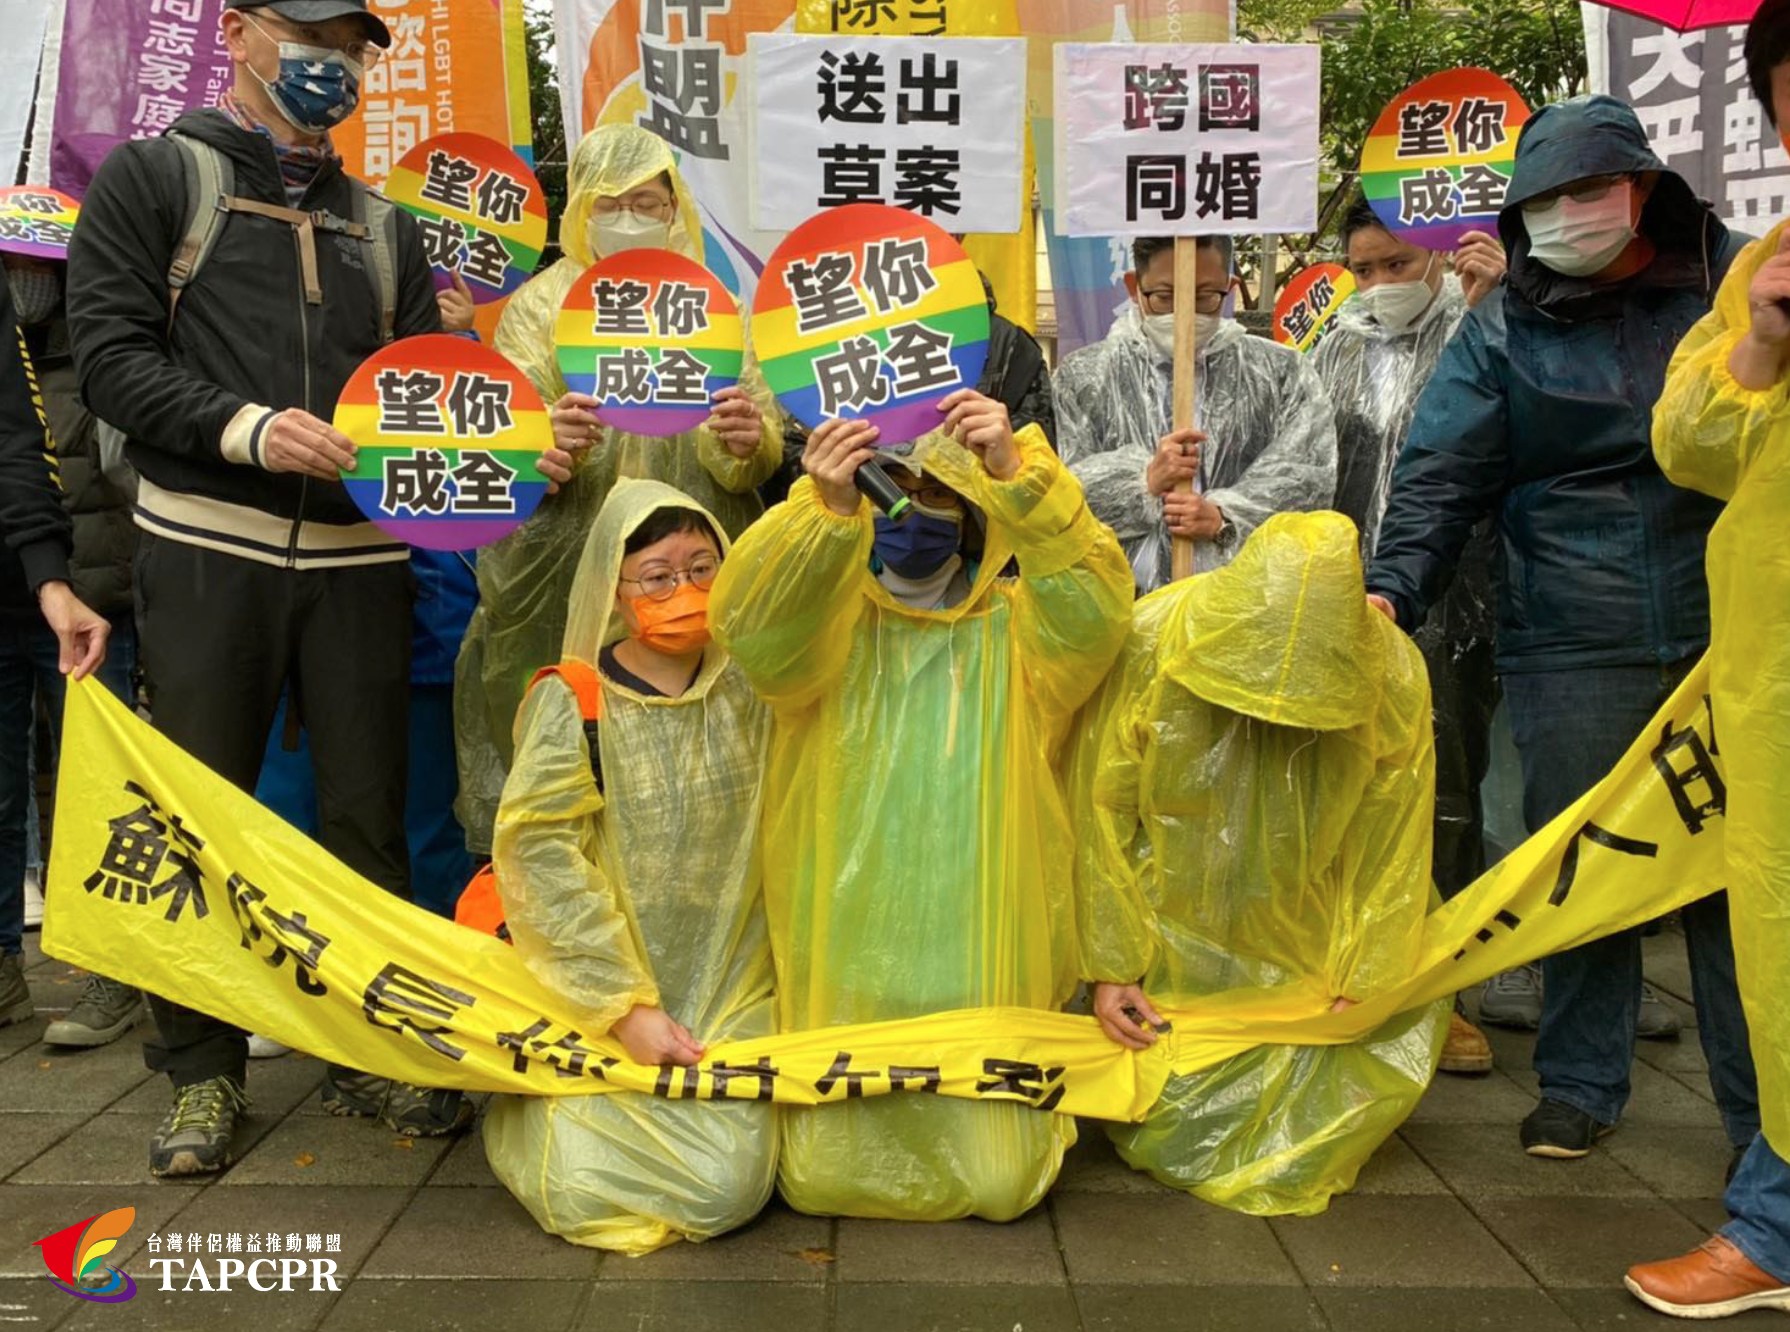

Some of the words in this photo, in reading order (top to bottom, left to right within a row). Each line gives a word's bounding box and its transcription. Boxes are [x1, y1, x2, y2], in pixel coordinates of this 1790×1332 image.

[432, 25, 452, 85] LGBT
[817, 50, 961, 126] 送出
[1122, 62, 1261, 133] 跨國
[1397, 98, 1507, 158] 望你
[420, 150, 529, 225] 望你
[817, 143, 962, 217] 草案
[1125, 151, 1262, 222] 同婚
[1399, 164, 1510, 223] 成全
[417, 216, 513, 288] 成全
[784, 239, 937, 334] 望你
[593, 279, 708, 336] 望你
[1281, 273, 1335, 346] 望你
[376, 370, 514, 436] 望你
[594, 348, 710, 403] 成全
[813, 321, 961, 416] 成全
[380, 448, 517, 515] 成全
